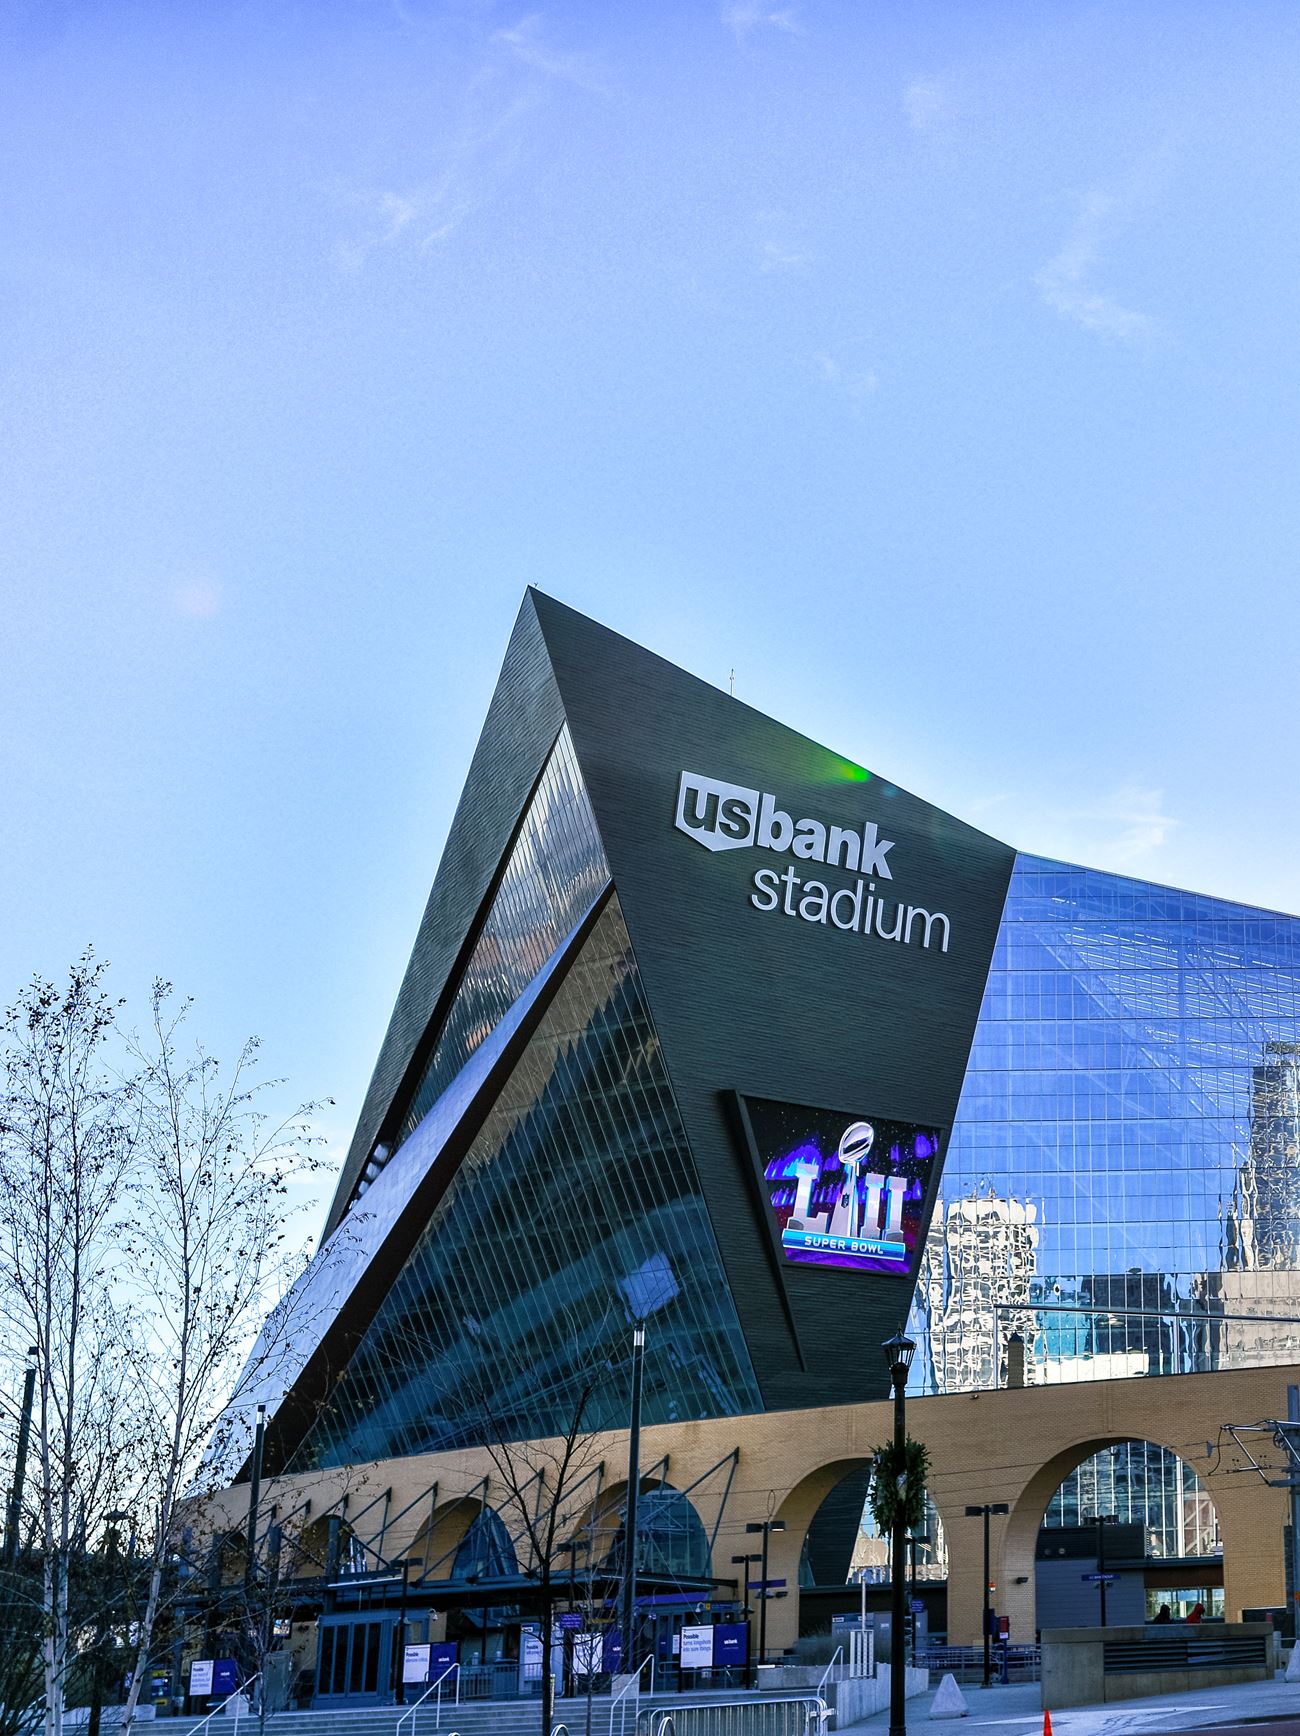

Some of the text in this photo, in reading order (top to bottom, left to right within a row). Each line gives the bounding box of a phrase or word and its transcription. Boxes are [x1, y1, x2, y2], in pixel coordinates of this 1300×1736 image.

[751, 866, 951, 953] stadium
[804, 1235, 884, 1255] SUPER BOWL
